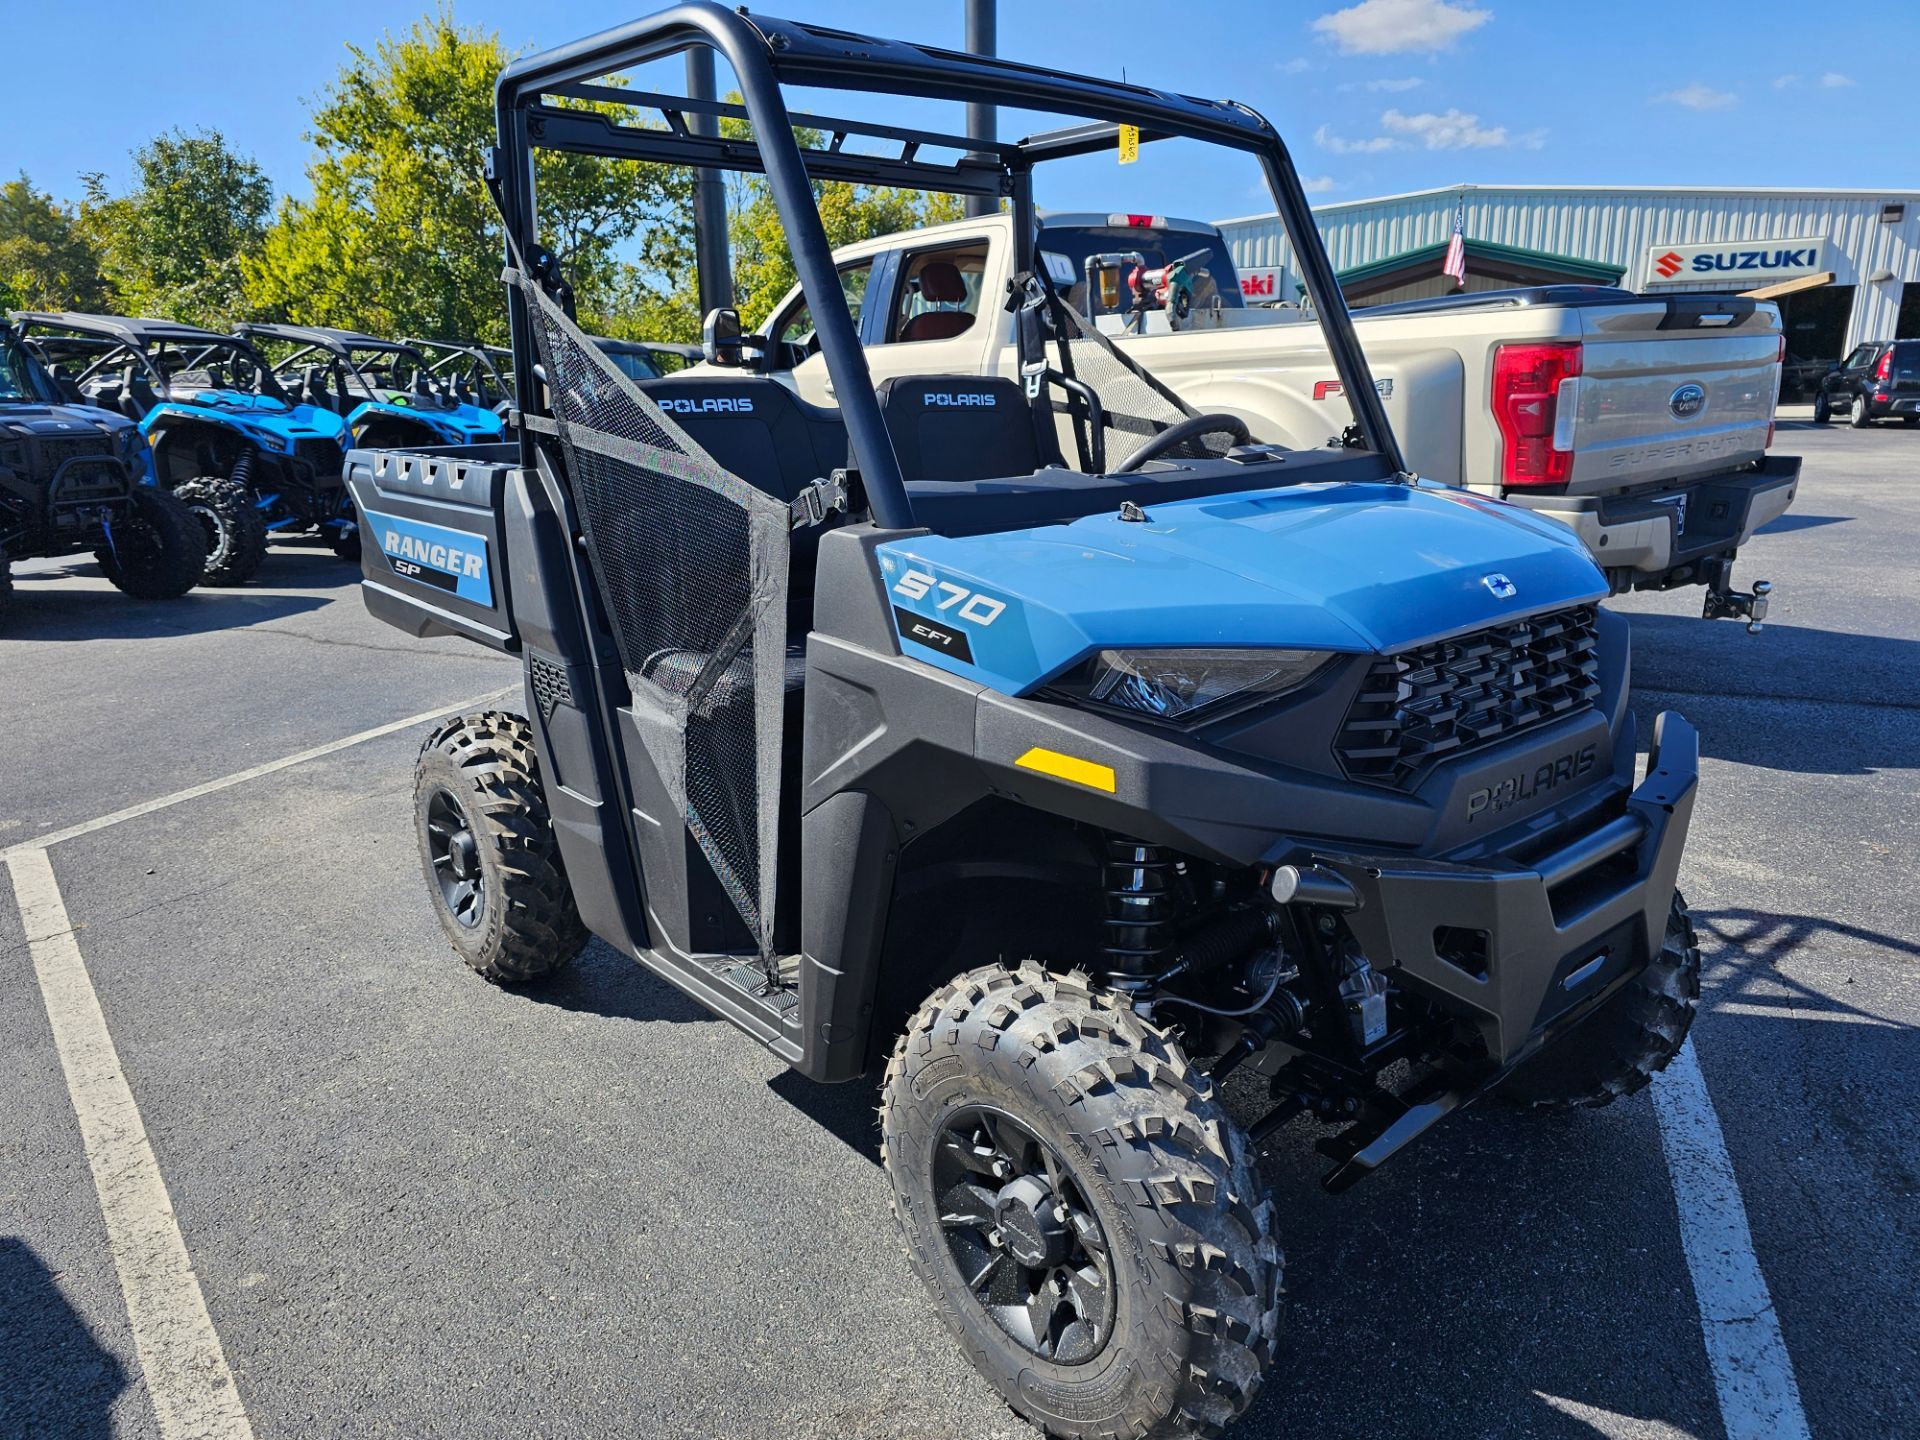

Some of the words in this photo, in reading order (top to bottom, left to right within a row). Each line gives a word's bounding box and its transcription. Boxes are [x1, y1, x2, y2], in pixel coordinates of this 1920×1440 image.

[1692, 249, 1817, 272] SUZUKI
[657, 398, 754, 413] POLARIS
[924, 394, 996, 406] POLARIS
[1609, 443, 1692, 467] SUPER
[385, 530, 483, 580] RANGER
[394, 560, 421, 575] SP
[893, 569, 1006, 626] 570
[911, 623, 953, 645] EFI
[1467, 742, 1597, 823] POLARIS
